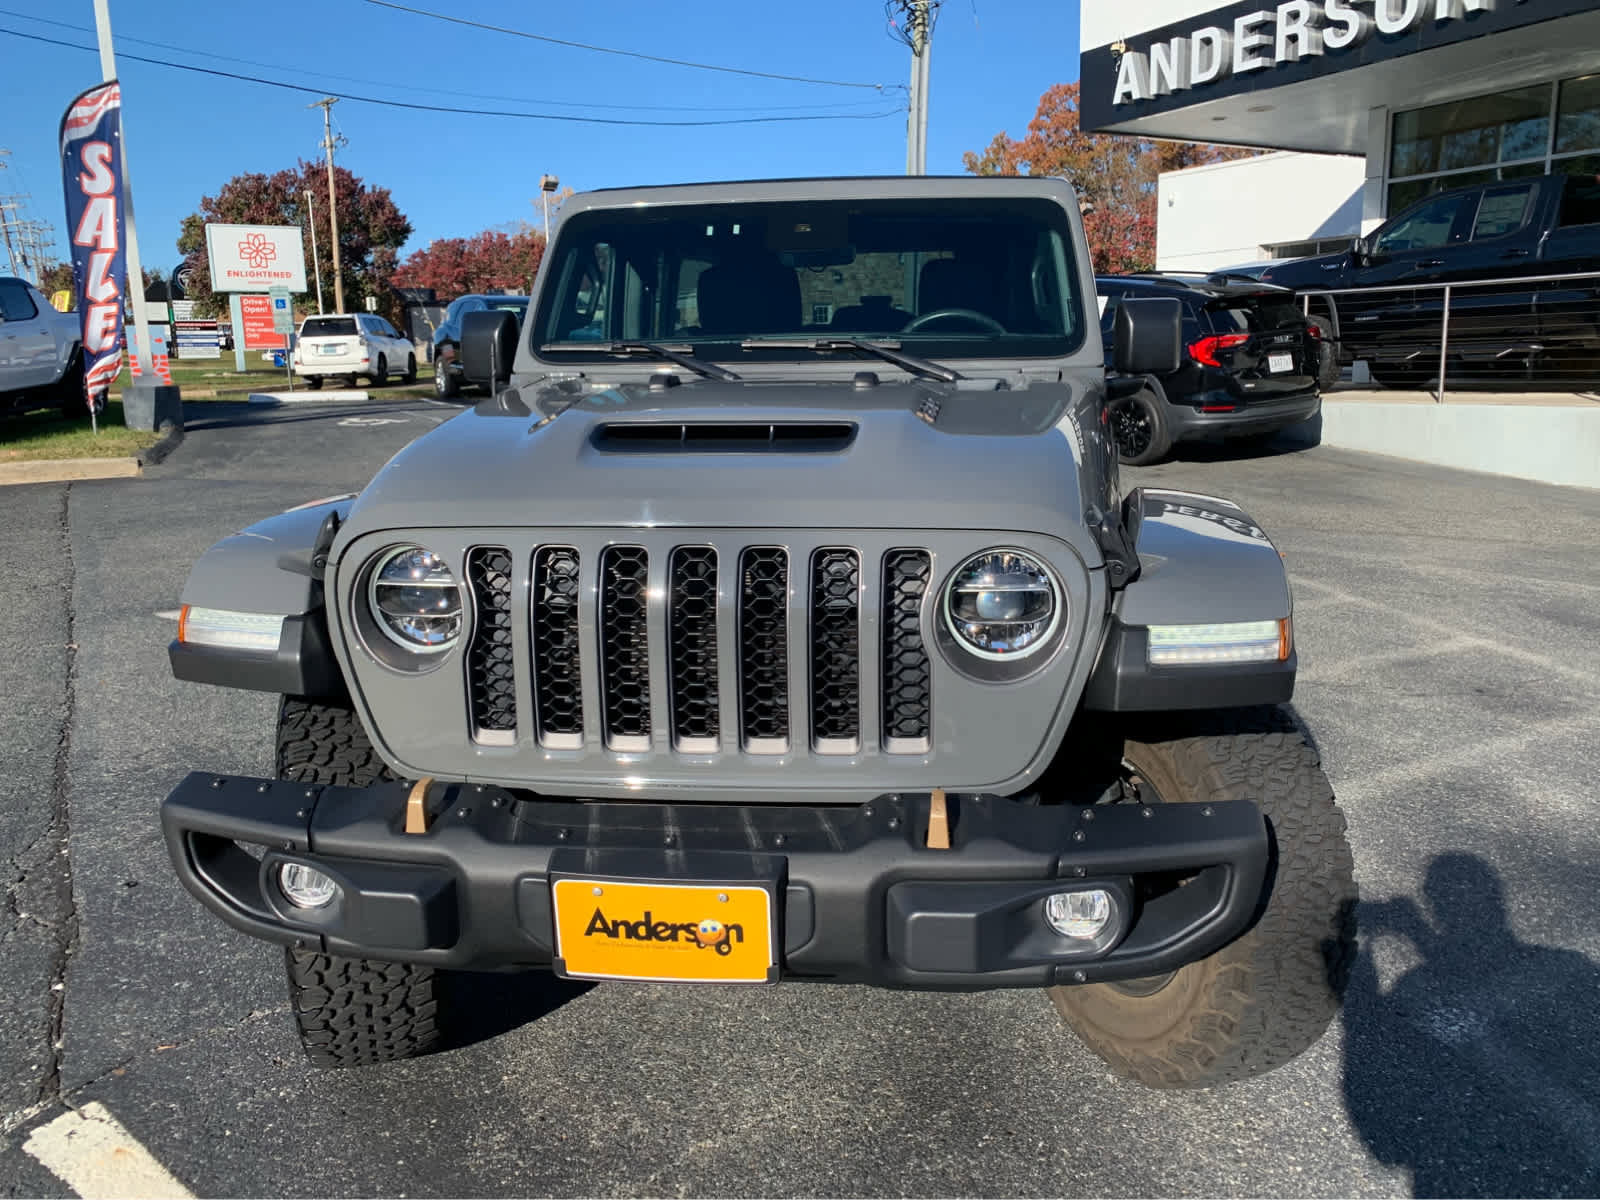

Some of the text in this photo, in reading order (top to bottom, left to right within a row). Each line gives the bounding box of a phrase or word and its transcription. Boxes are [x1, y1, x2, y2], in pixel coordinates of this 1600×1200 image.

[1112, 0, 1495, 105] ANDERSO
[74, 140, 119, 354] SALE
[226, 270, 292, 279] ENLIGHTENED
[584, 906, 744, 946] Anderson
